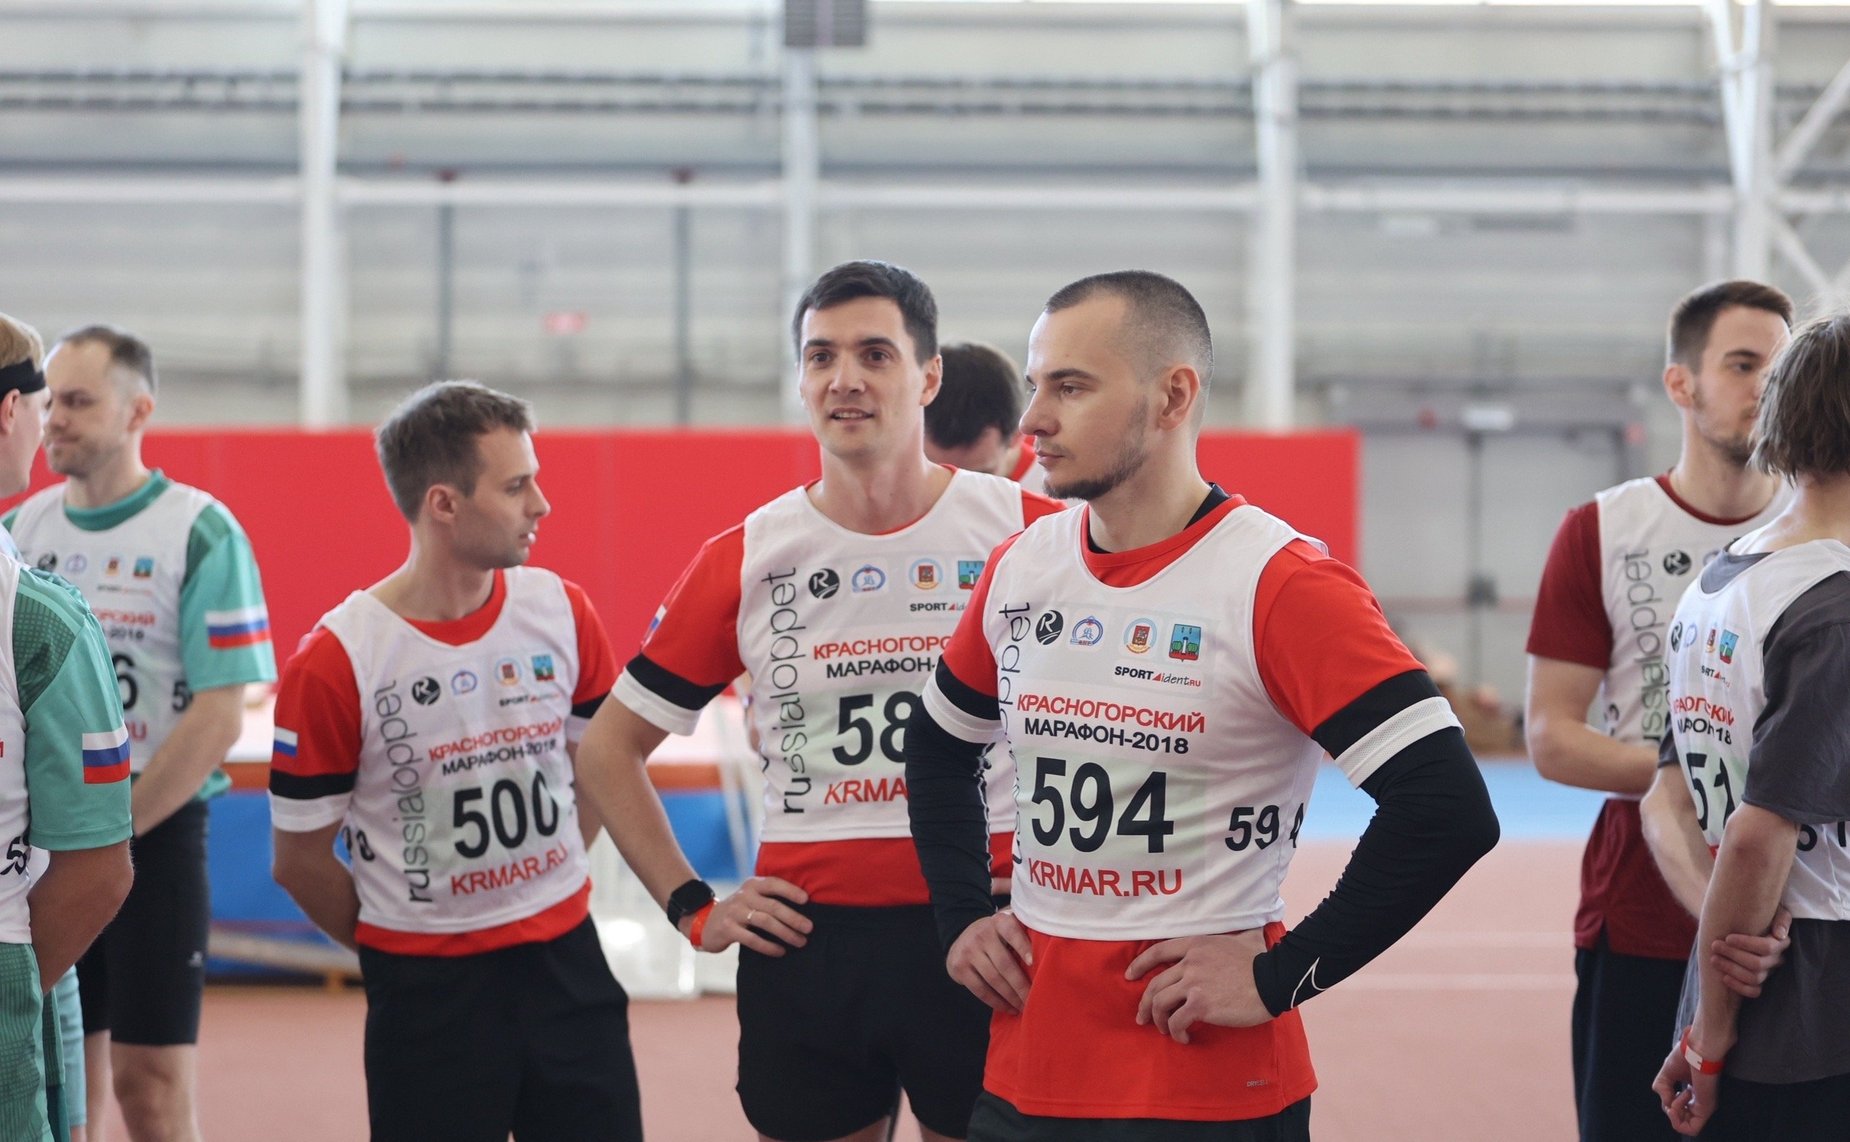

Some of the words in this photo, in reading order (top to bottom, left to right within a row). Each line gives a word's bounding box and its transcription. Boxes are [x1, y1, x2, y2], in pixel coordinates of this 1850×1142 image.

[761, 567, 811, 814] russialoppet
[1017, 694, 1206, 734] КРАСНОГОРСКИЙ
[1024, 717, 1189, 754] МАРАФОН-2018
[453, 770, 559, 859] 500
[1031, 756, 1174, 853] 594
[450, 841, 569, 897] KRMAR.RU
[1028, 858, 1182, 897] KRMAR.RU
